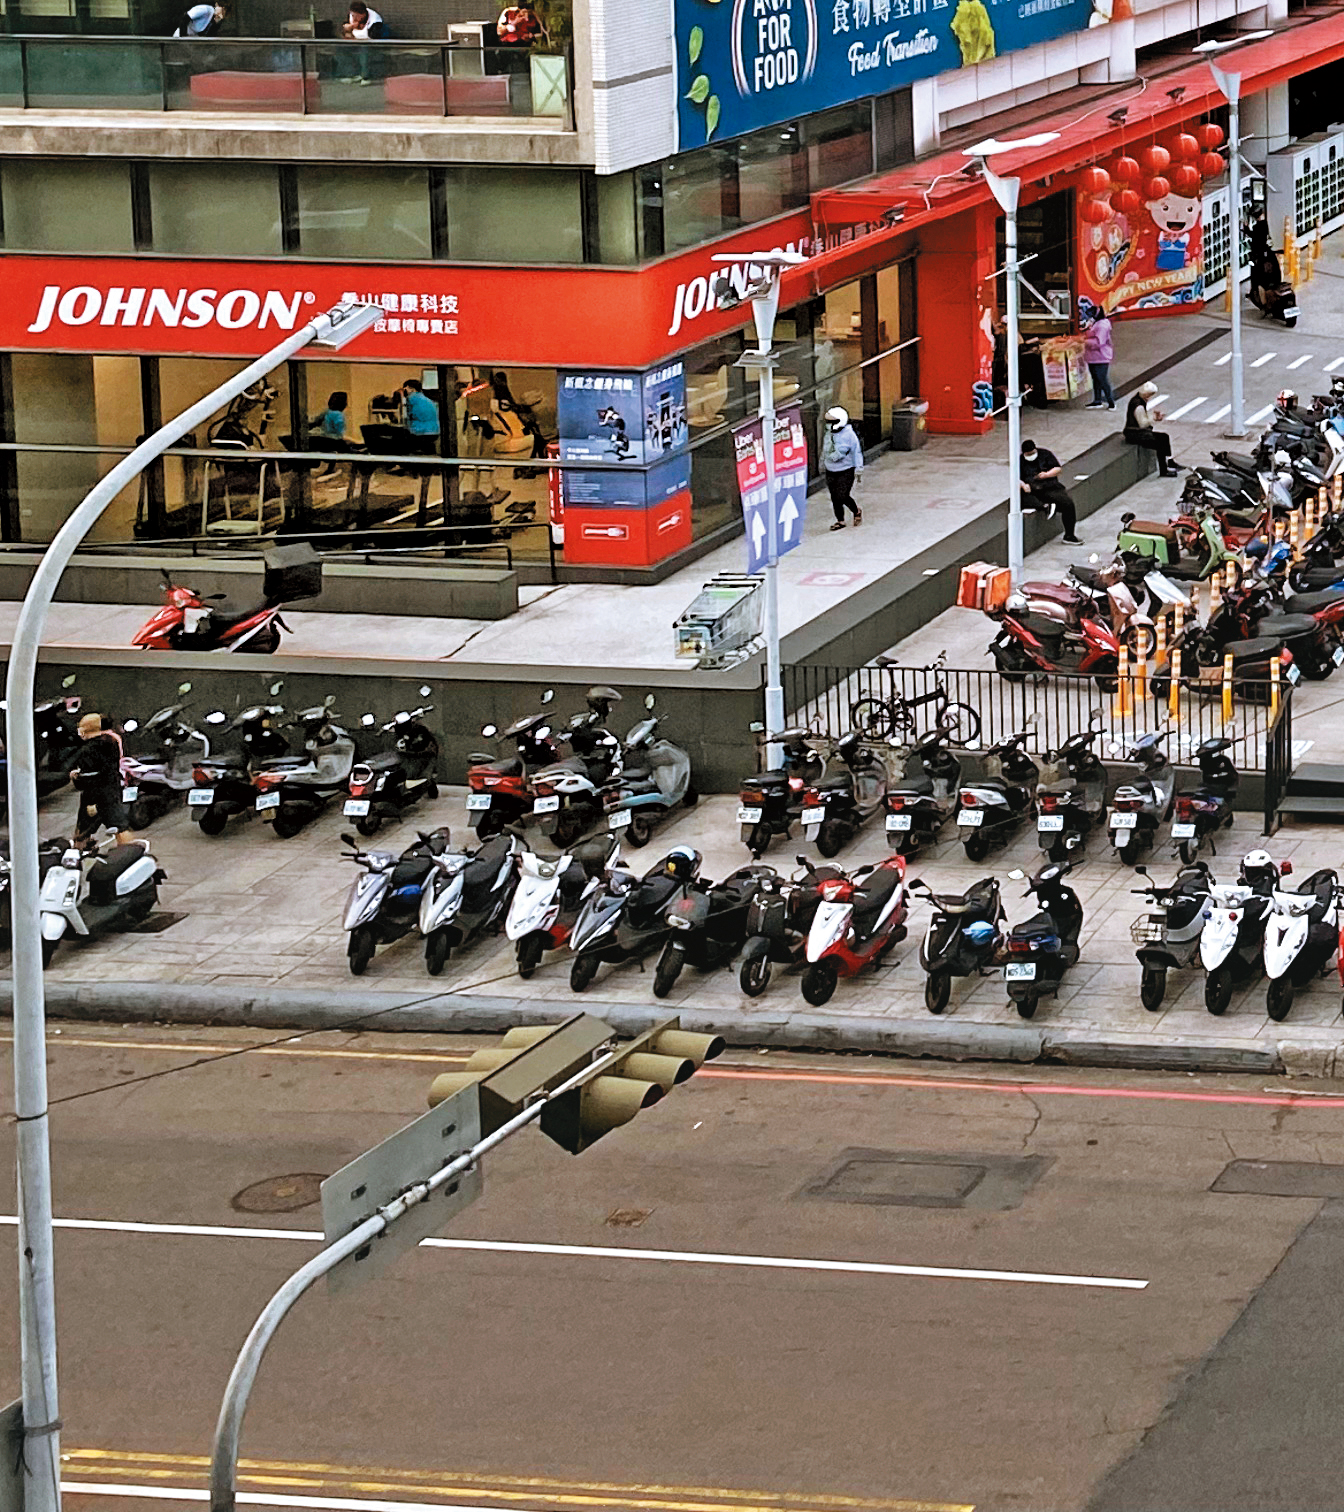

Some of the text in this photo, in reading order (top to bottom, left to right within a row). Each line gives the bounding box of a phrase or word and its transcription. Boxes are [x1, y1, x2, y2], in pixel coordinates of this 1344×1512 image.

[758, 13, 792, 54] FOR
[754, 48, 799, 93] FOOD
[28, 285, 303, 333] JOHNSON
